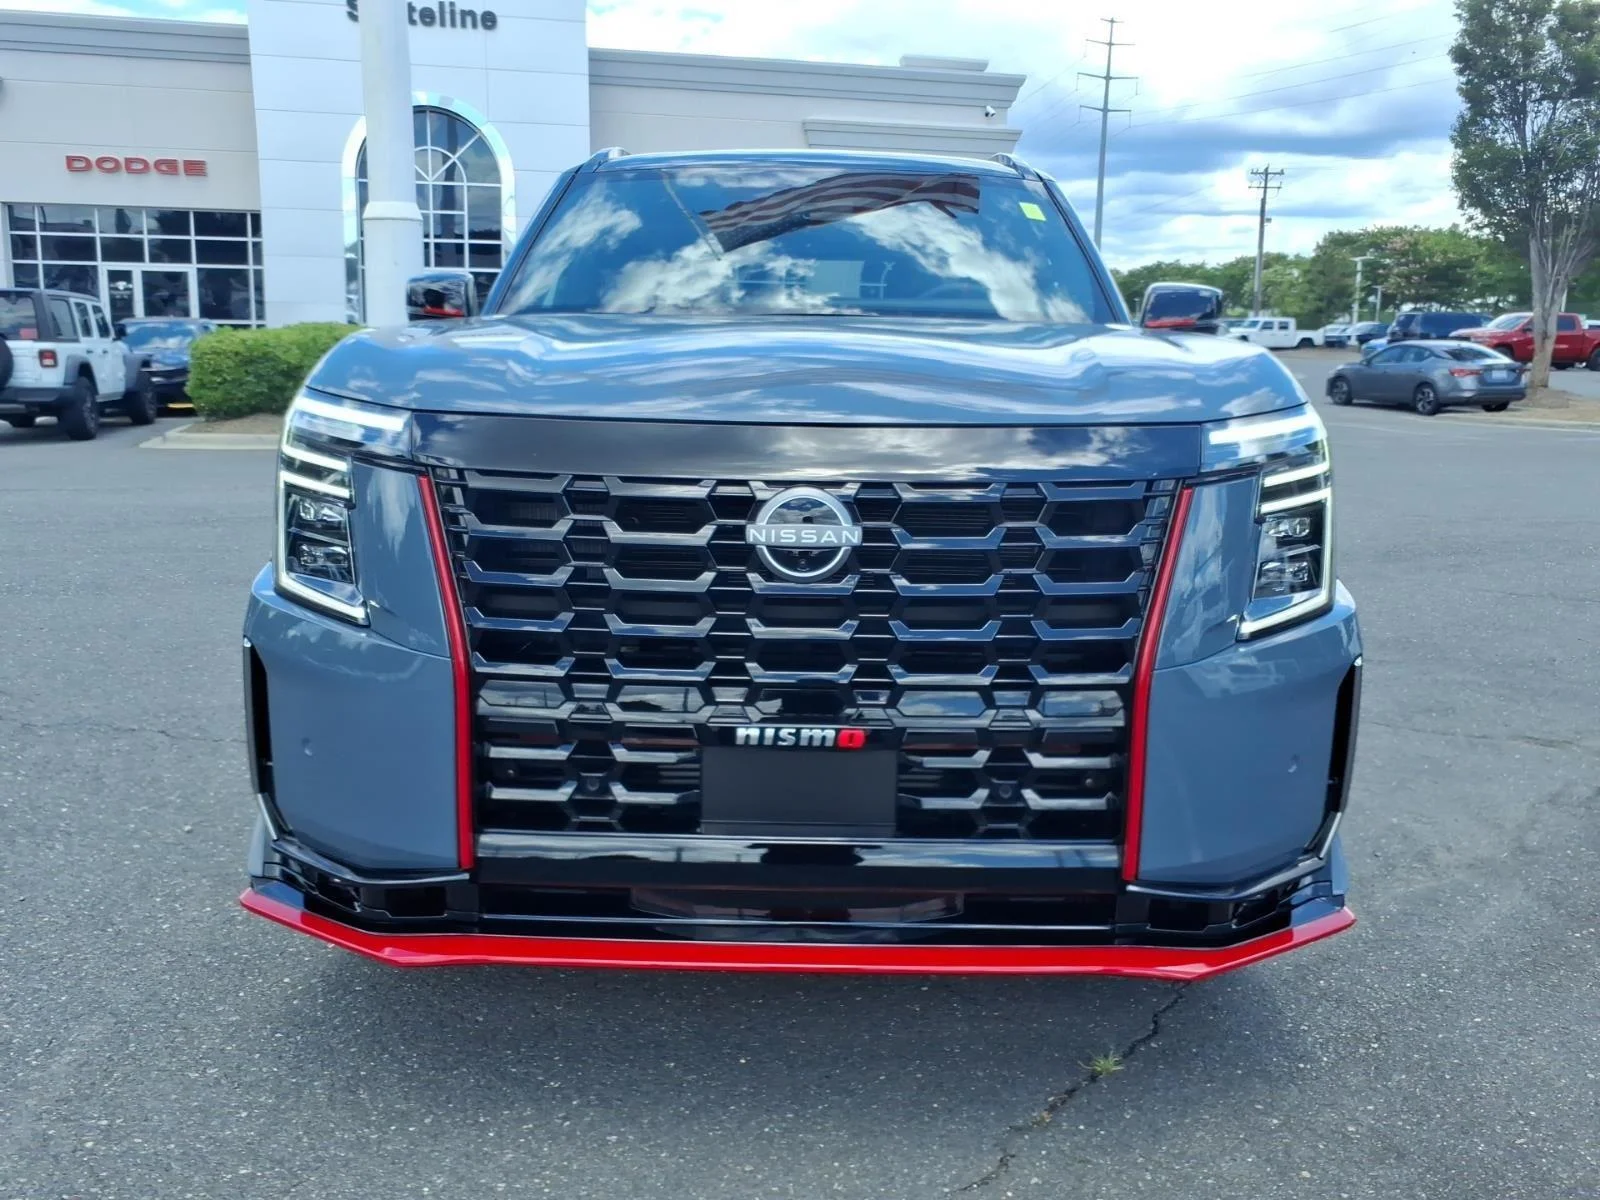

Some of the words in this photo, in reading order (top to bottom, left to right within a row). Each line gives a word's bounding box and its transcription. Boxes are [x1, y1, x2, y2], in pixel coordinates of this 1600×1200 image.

[346, 0, 498, 30] Steline
[65, 155, 207, 177] DODGE
[749, 528, 859, 544] NISSAN
[735, 727, 866, 748] nismo
